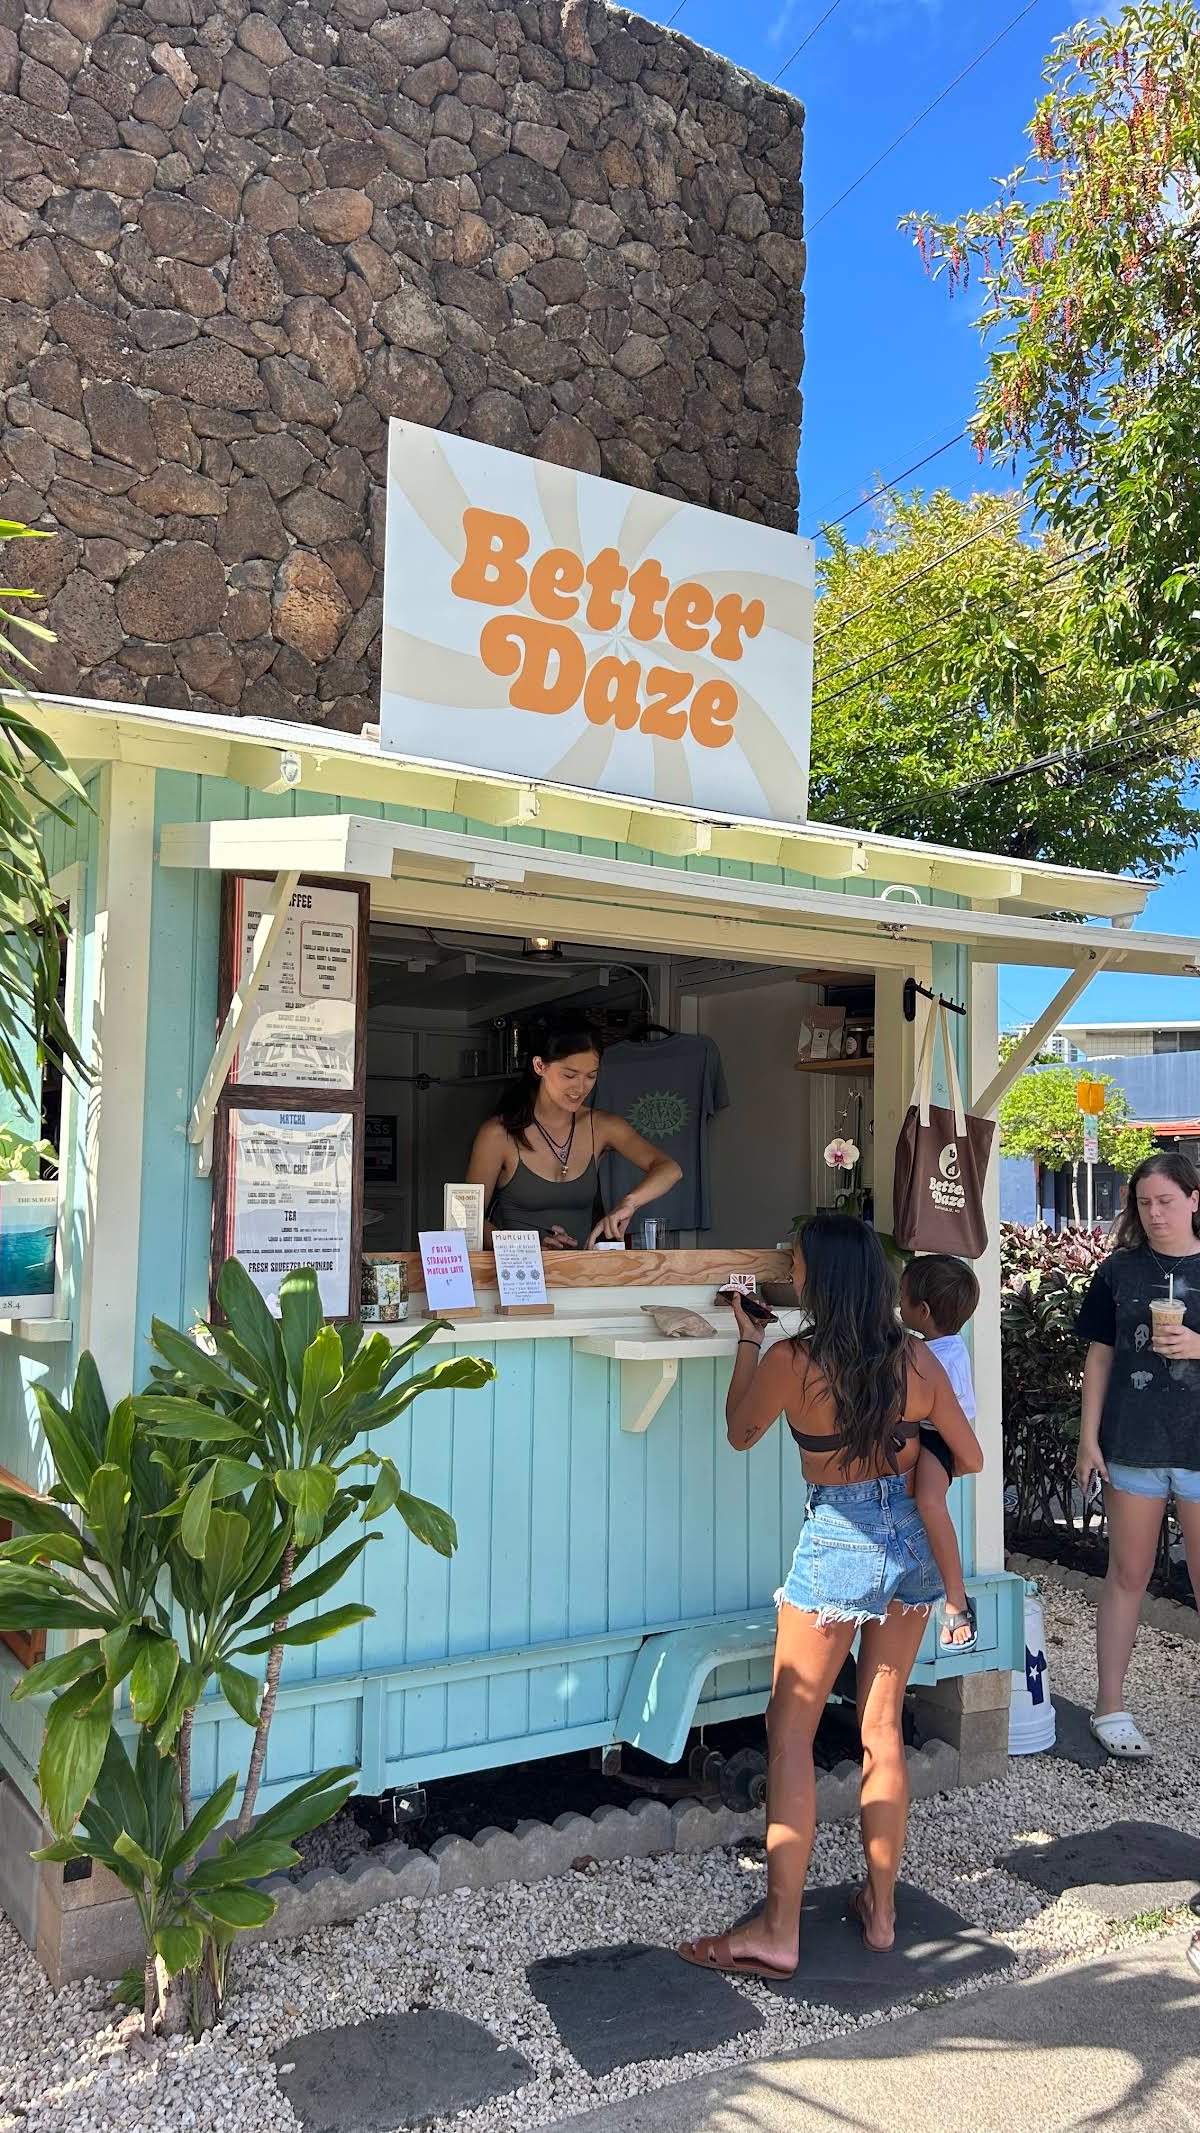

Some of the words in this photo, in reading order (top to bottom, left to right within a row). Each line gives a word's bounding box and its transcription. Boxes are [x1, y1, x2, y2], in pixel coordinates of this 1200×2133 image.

[451, 507, 765, 661] Better
[480, 614, 739, 749] Daze
[289, 893, 312, 908] FFEE
[280, 1113, 306, 1125] MATCHA
[293, 1164, 308, 1175] CHAI
[931, 1190, 965, 1208] Daze
[284, 1211, 297, 1222] TEA
[426, 1255, 462, 1266] STRAWBERRY
[248, 1262, 269, 1273] FRESH
[426, 1267, 449, 1276] MATCHA
